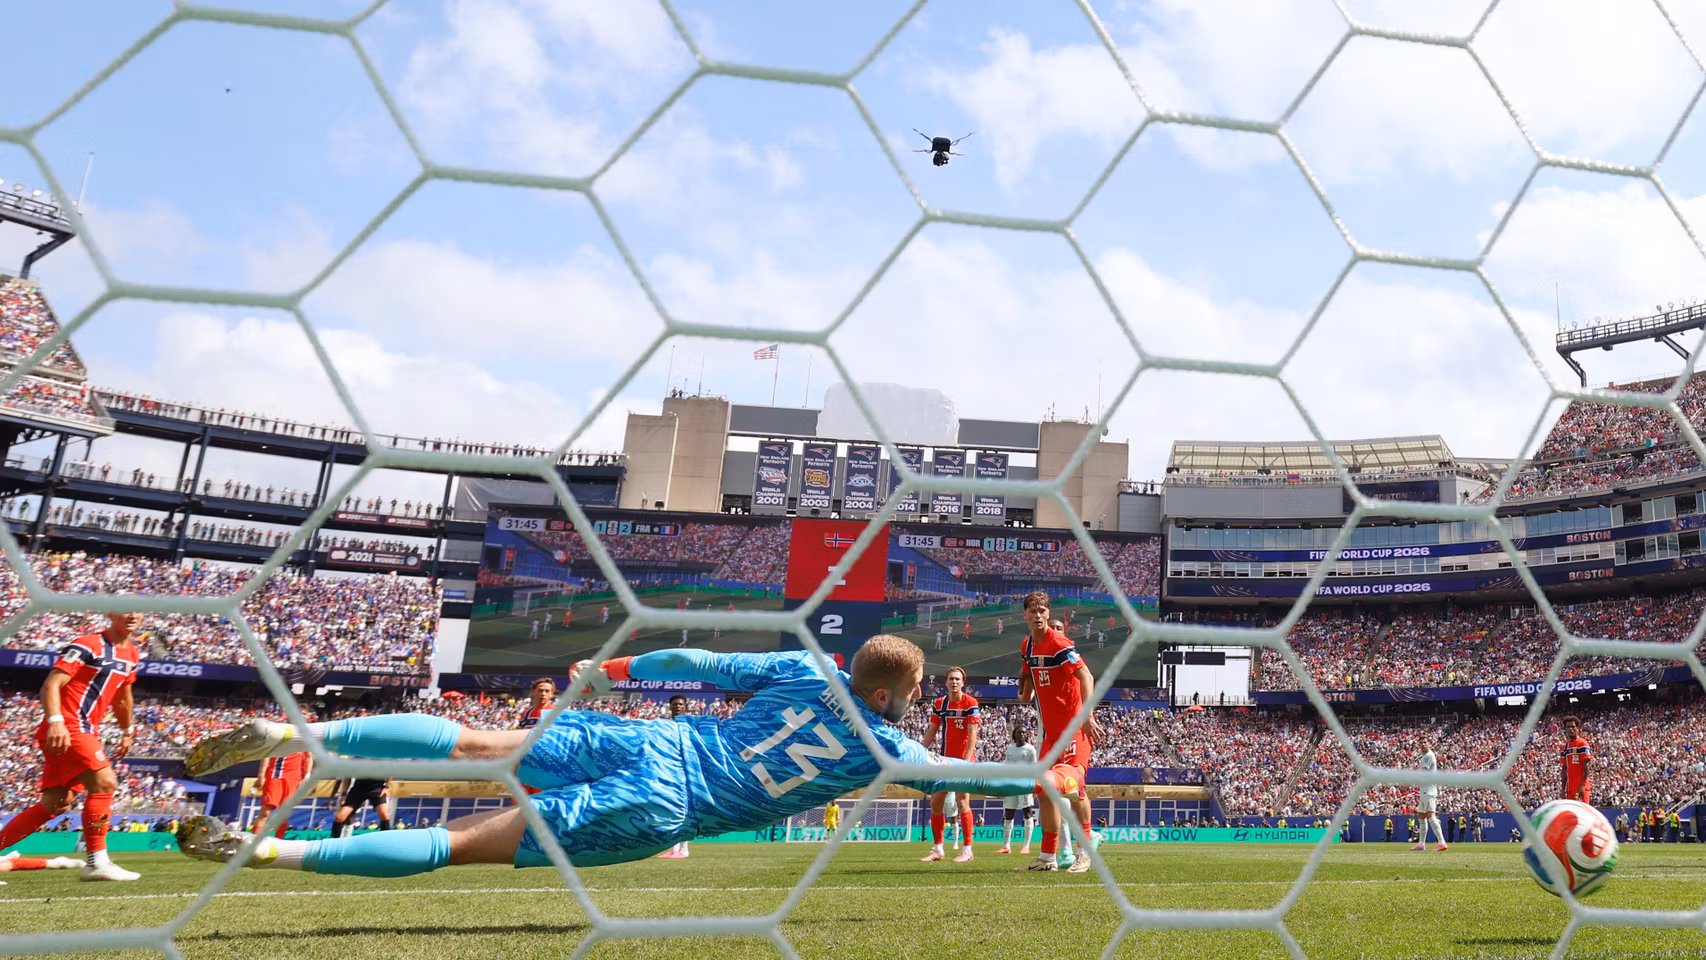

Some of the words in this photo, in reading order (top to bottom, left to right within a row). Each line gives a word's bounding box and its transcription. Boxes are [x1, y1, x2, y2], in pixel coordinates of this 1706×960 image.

[756, 497, 783, 505] 2001
[800, 499, 829, 507] 2003
[845, 501, 873, 509] 2004
[934, 505, 958, 513] 2016
[977, 507, 1001, 515] 2018
[505, 519, 538, 529] 31:45
[635, 524, 650, 533] FRA
[904, 536, 934, 546] 31:45
[1566, 530, 1611, 543] BOSTON
[965, 538, 981, 547] NOR
[1020, 541, 1034, 550] FRA
[347, 551, 374, 562] 2021
[1372, 549, 1392, 558] CUP
[1394, 547, 1430, 557] 2026
[1568, 568, 1614, 580] BOSTON
[1332, 585, 1370, 594] WORLD
[1372, 584, 1393, 593] CUP
[1394, 582, 1431, 592] 2026
[820, 614, 844, 634] 2
[14, 652, 50, 666] FIFA
[146, 662, 202, 677] 2026
[641, 680, 663, 689] CUP
[664, 681, 702, 690] 2026
[1474, 686, 1496, 696] FIFA
[1498, 684, 1535, 695] WORLD
[1557, 680, 1592, 691] 2026
[739, 706, 848, 799] 13
[1480, 818, 1494, 829] FIFA
[1255, 831, 1309, 840] HYUNDAI
